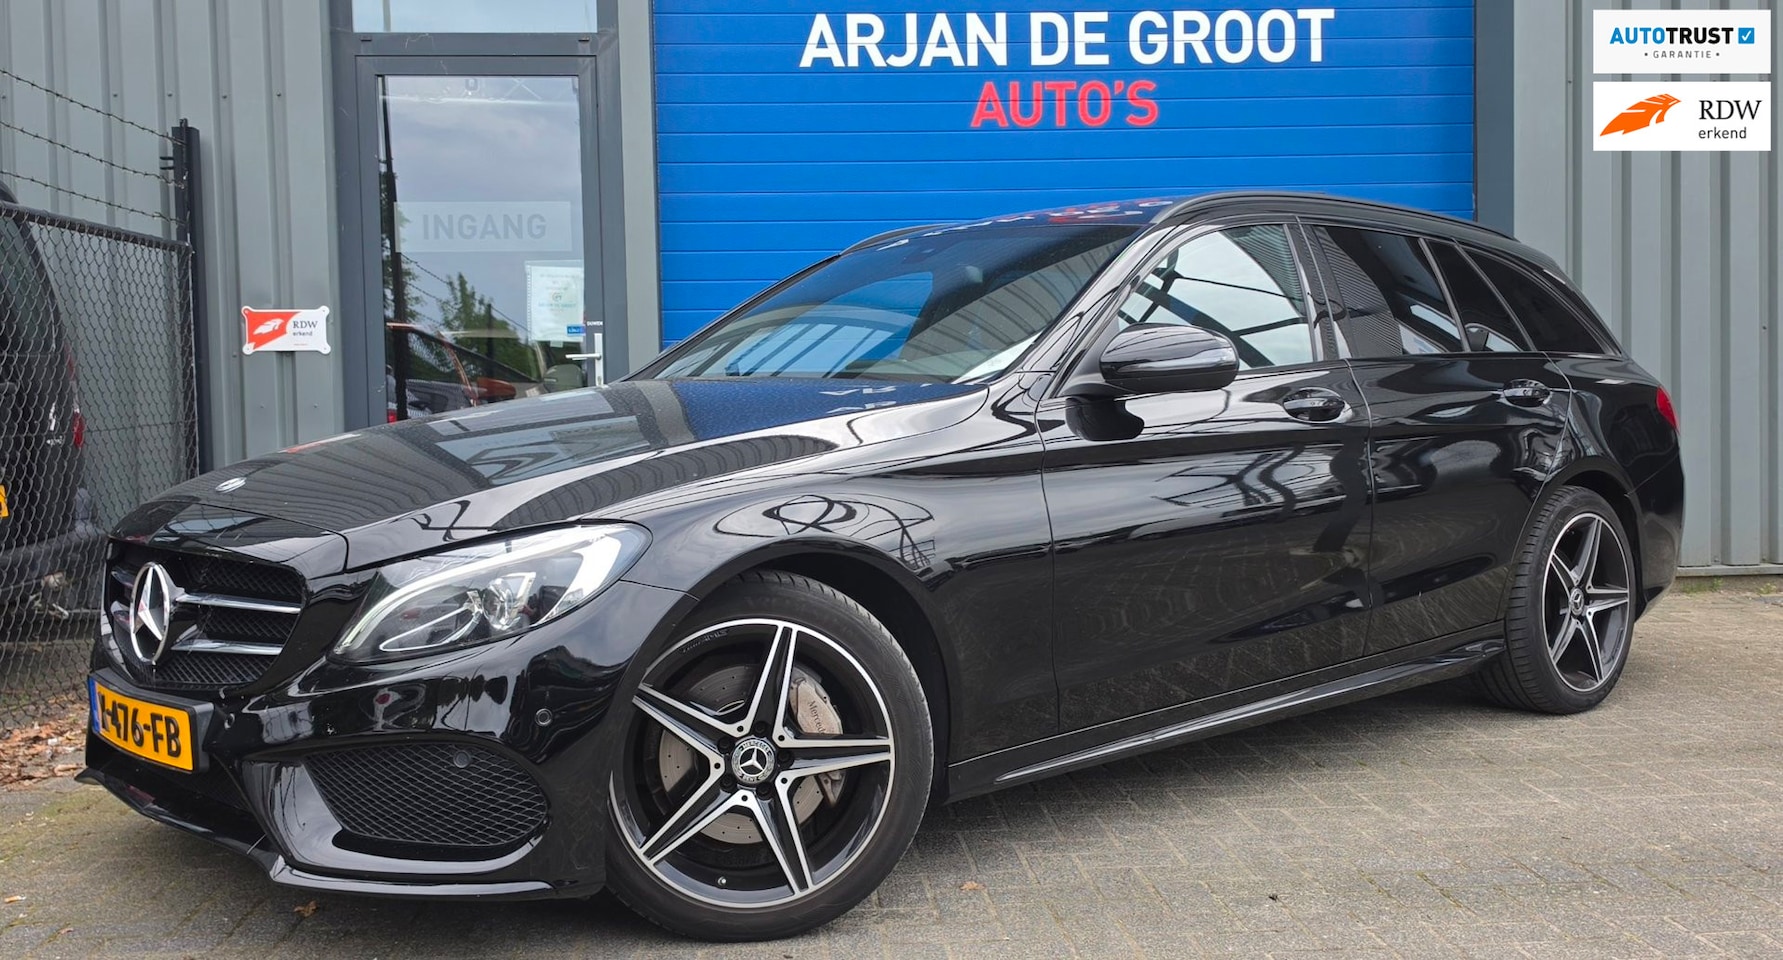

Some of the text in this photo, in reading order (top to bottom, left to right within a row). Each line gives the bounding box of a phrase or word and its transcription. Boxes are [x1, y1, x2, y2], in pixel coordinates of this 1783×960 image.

[800, 9, 1334, 67] ARJAN DE GROOT
[971, 80, 1158, 127] AUTO'S
[423, 214, 547, 240] INGANG
[293, 320, 318, 329] RDW
